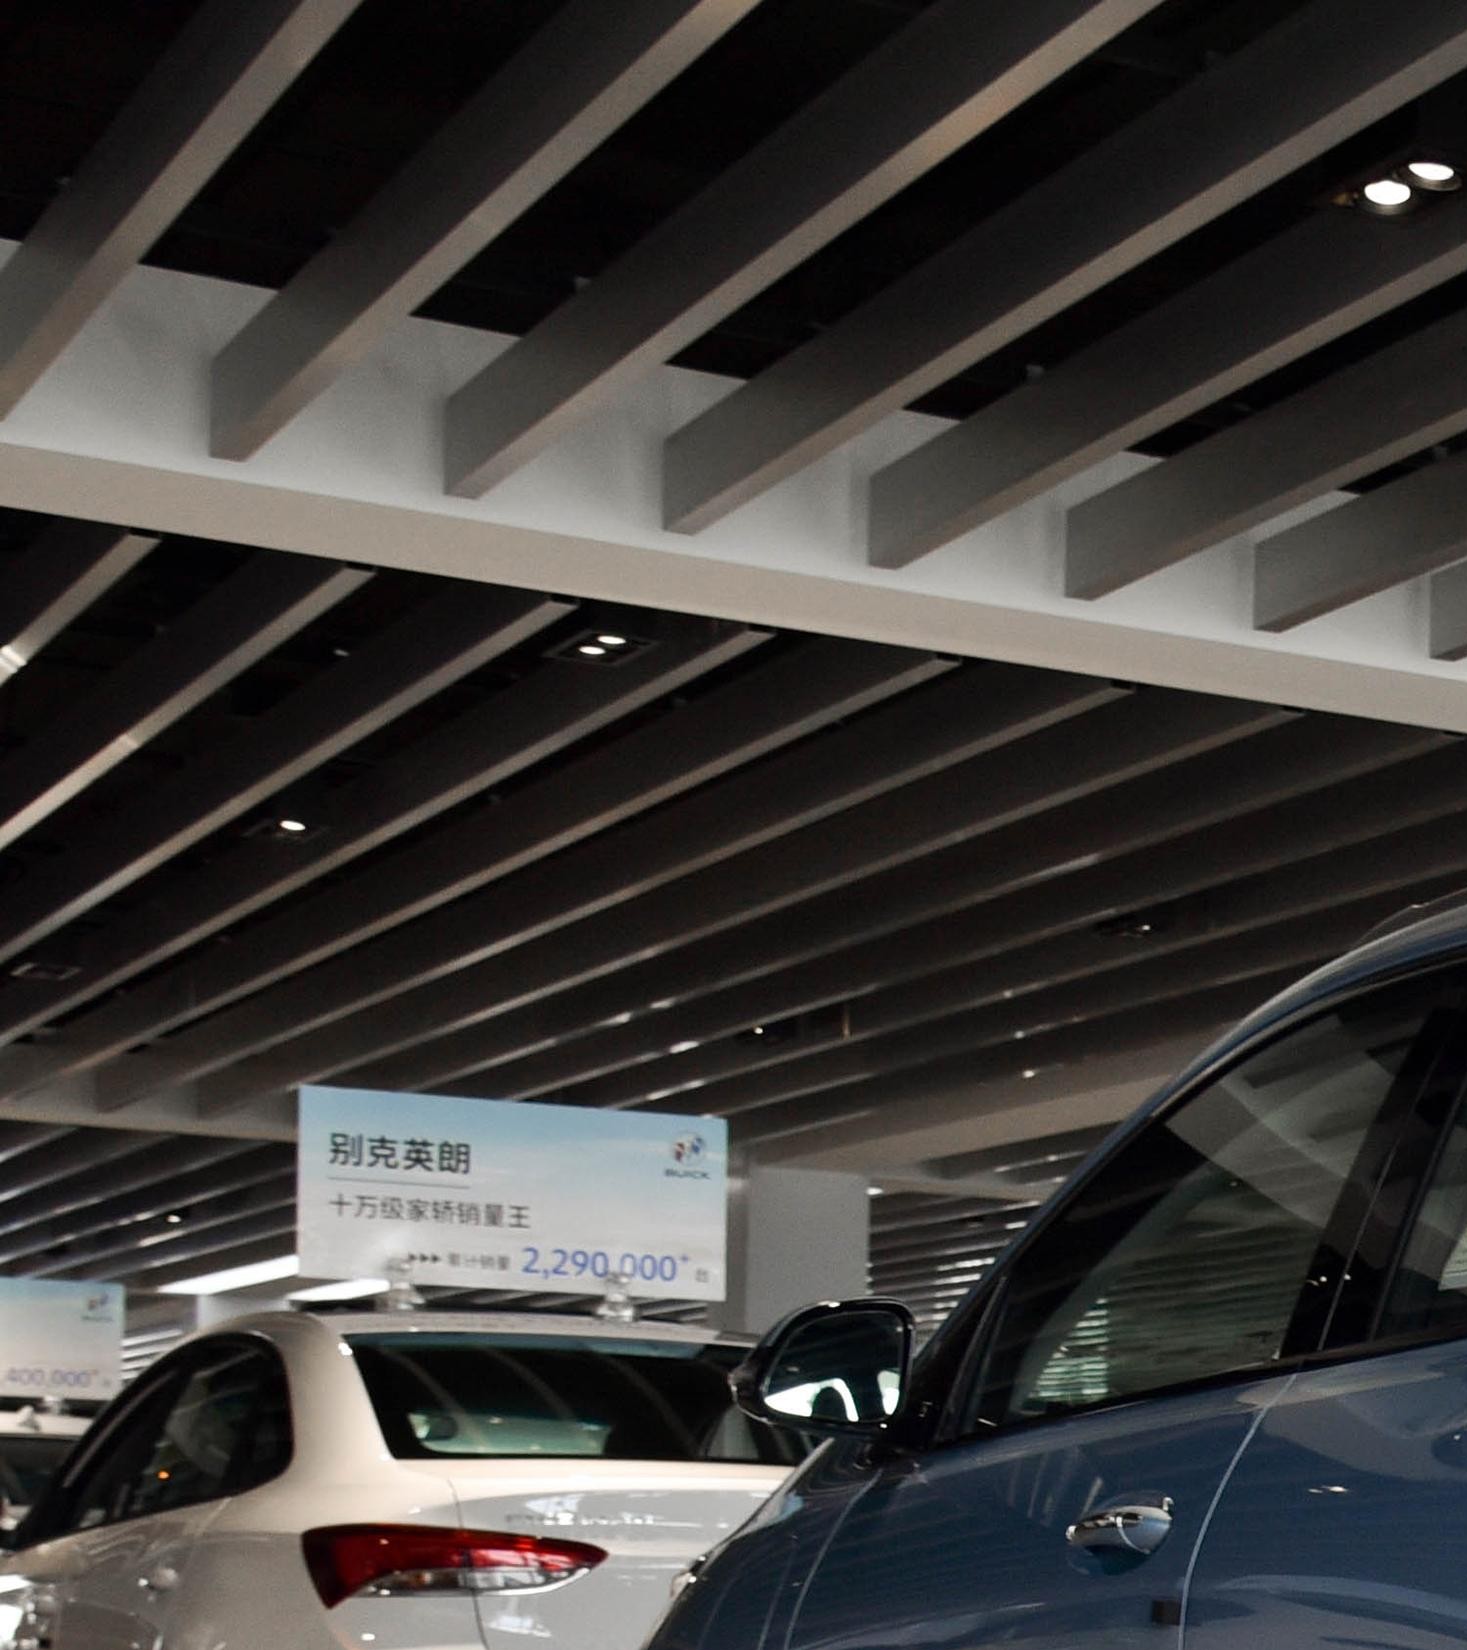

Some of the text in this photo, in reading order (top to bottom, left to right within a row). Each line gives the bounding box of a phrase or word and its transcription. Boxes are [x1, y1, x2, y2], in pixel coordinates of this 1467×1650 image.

[328, 1132, 471, 1174] 别克英朗
[328, 1194, 531, 1229] 十万级家轿销量王
[521, 1246, 689, 1283] 2,290000+
